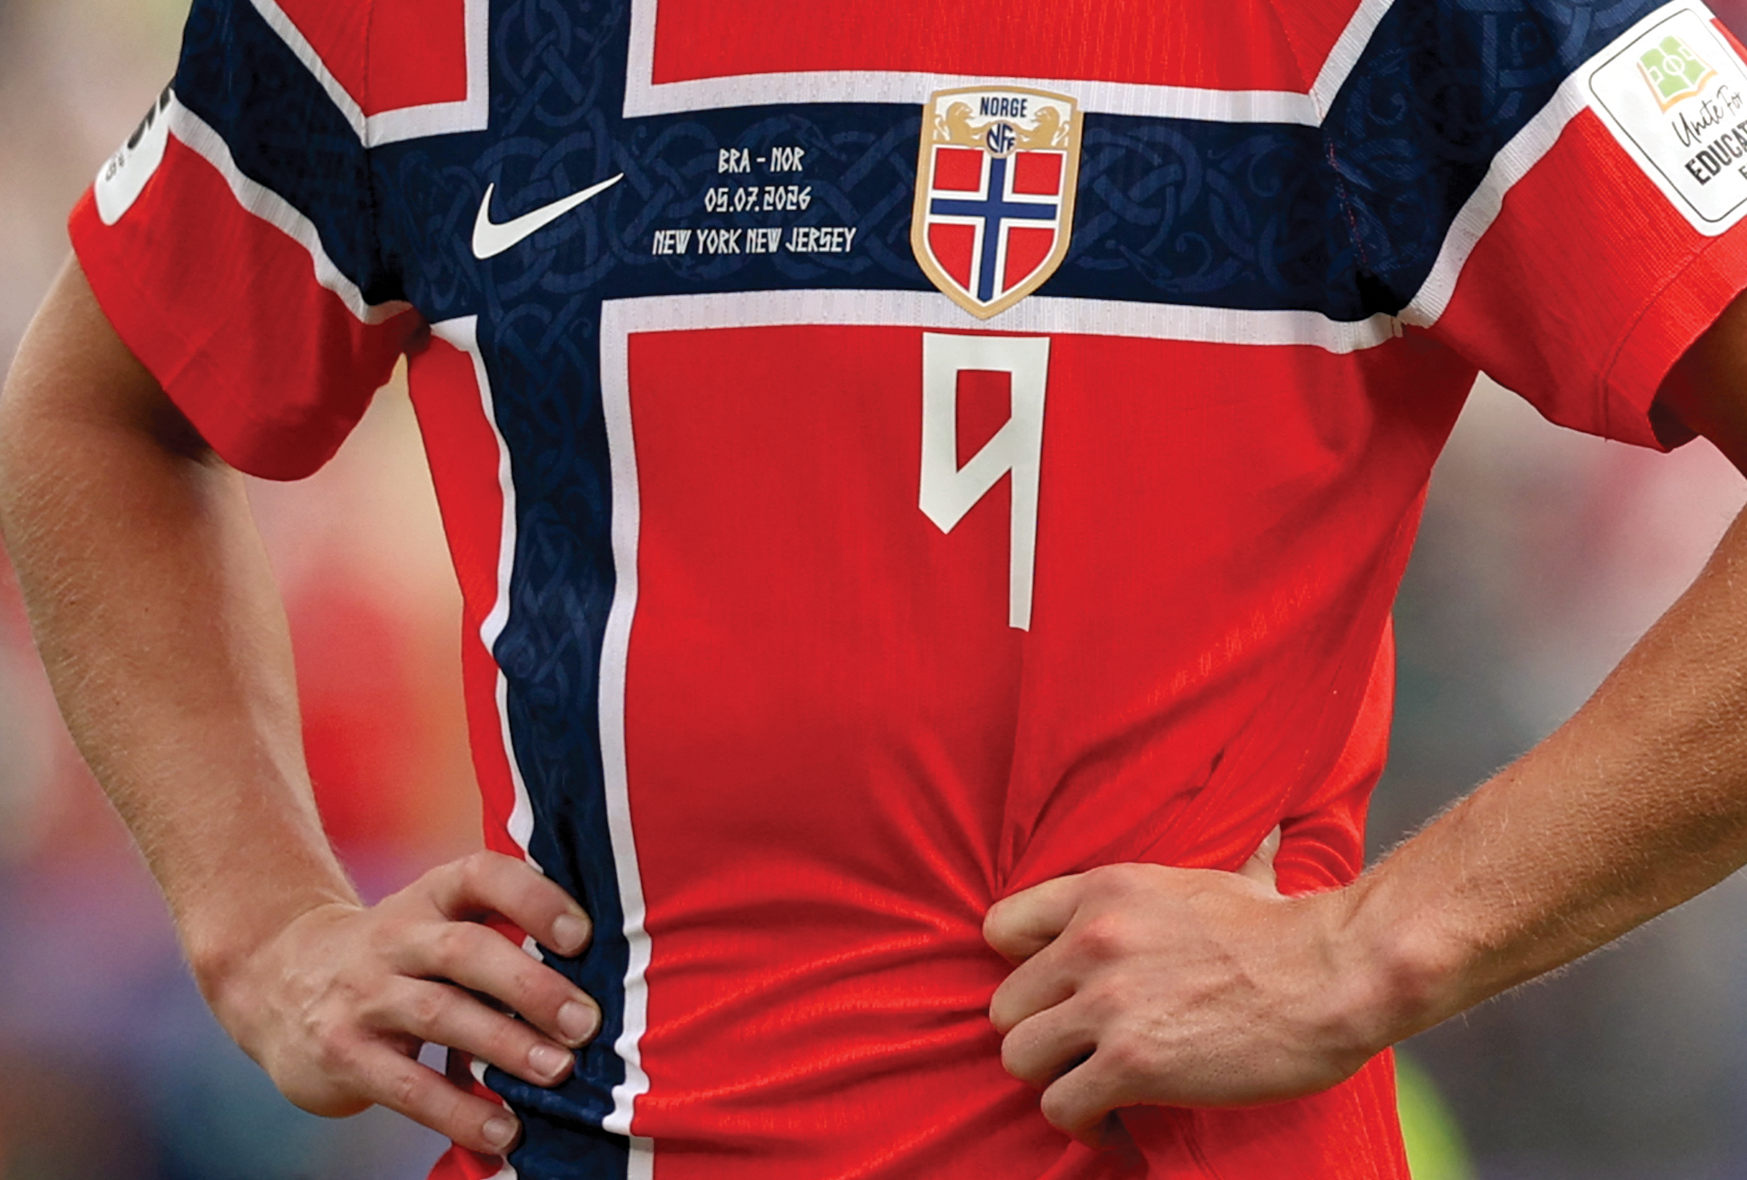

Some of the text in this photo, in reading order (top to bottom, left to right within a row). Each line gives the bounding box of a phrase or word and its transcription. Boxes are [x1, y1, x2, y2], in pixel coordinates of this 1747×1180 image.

[980, 96, 1028, 118] NORGE
[717, 147, 751, 173] BRA
[770, 146, 805, 172] NOR
[704, 185, 812, 213] 05.07.2026
[652, 227, 857, 255] NEW YORK NEW JERSEY
[918, 331, 1050, 633] 9
